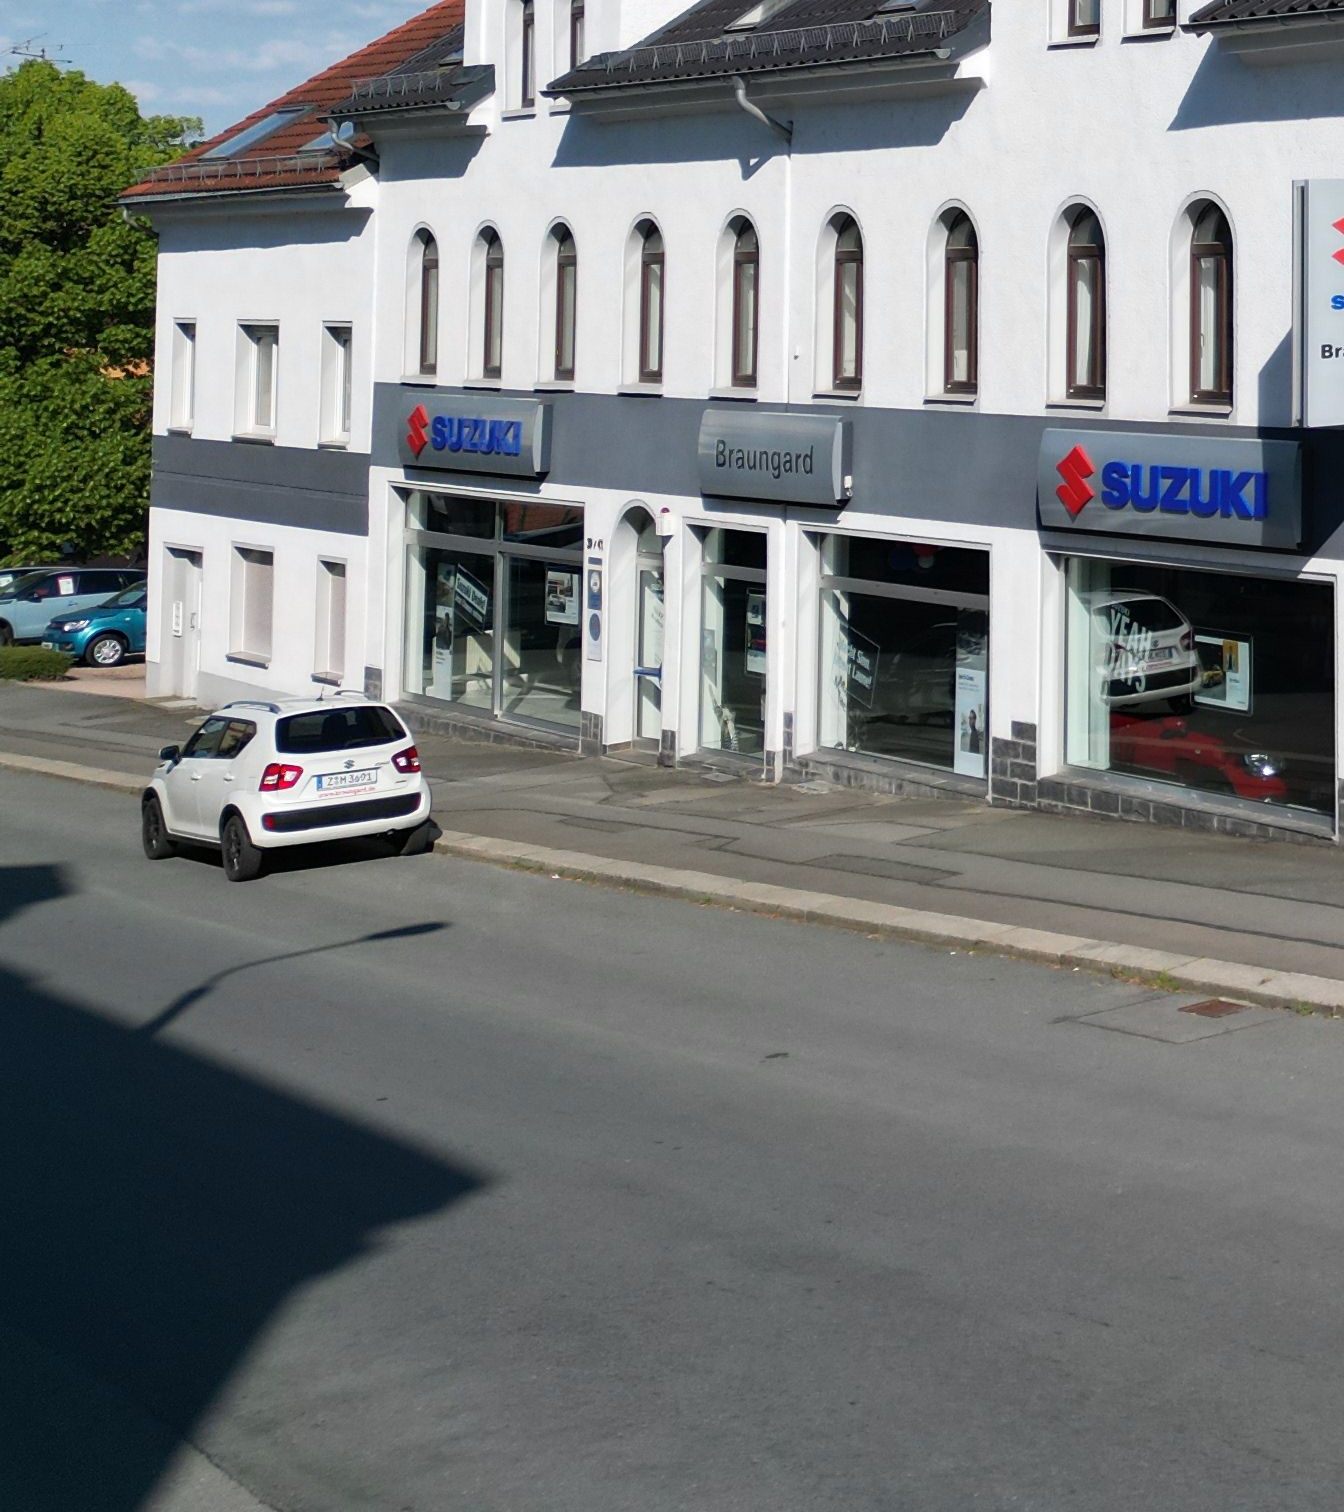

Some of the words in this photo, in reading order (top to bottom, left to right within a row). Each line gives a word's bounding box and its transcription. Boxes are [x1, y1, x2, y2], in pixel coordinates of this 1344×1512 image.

[431, 416, 522, 456] SUZUKI
[715, 439, 813, 479] Braungard
[1101, 461, 1268, 521] SUZUKI
